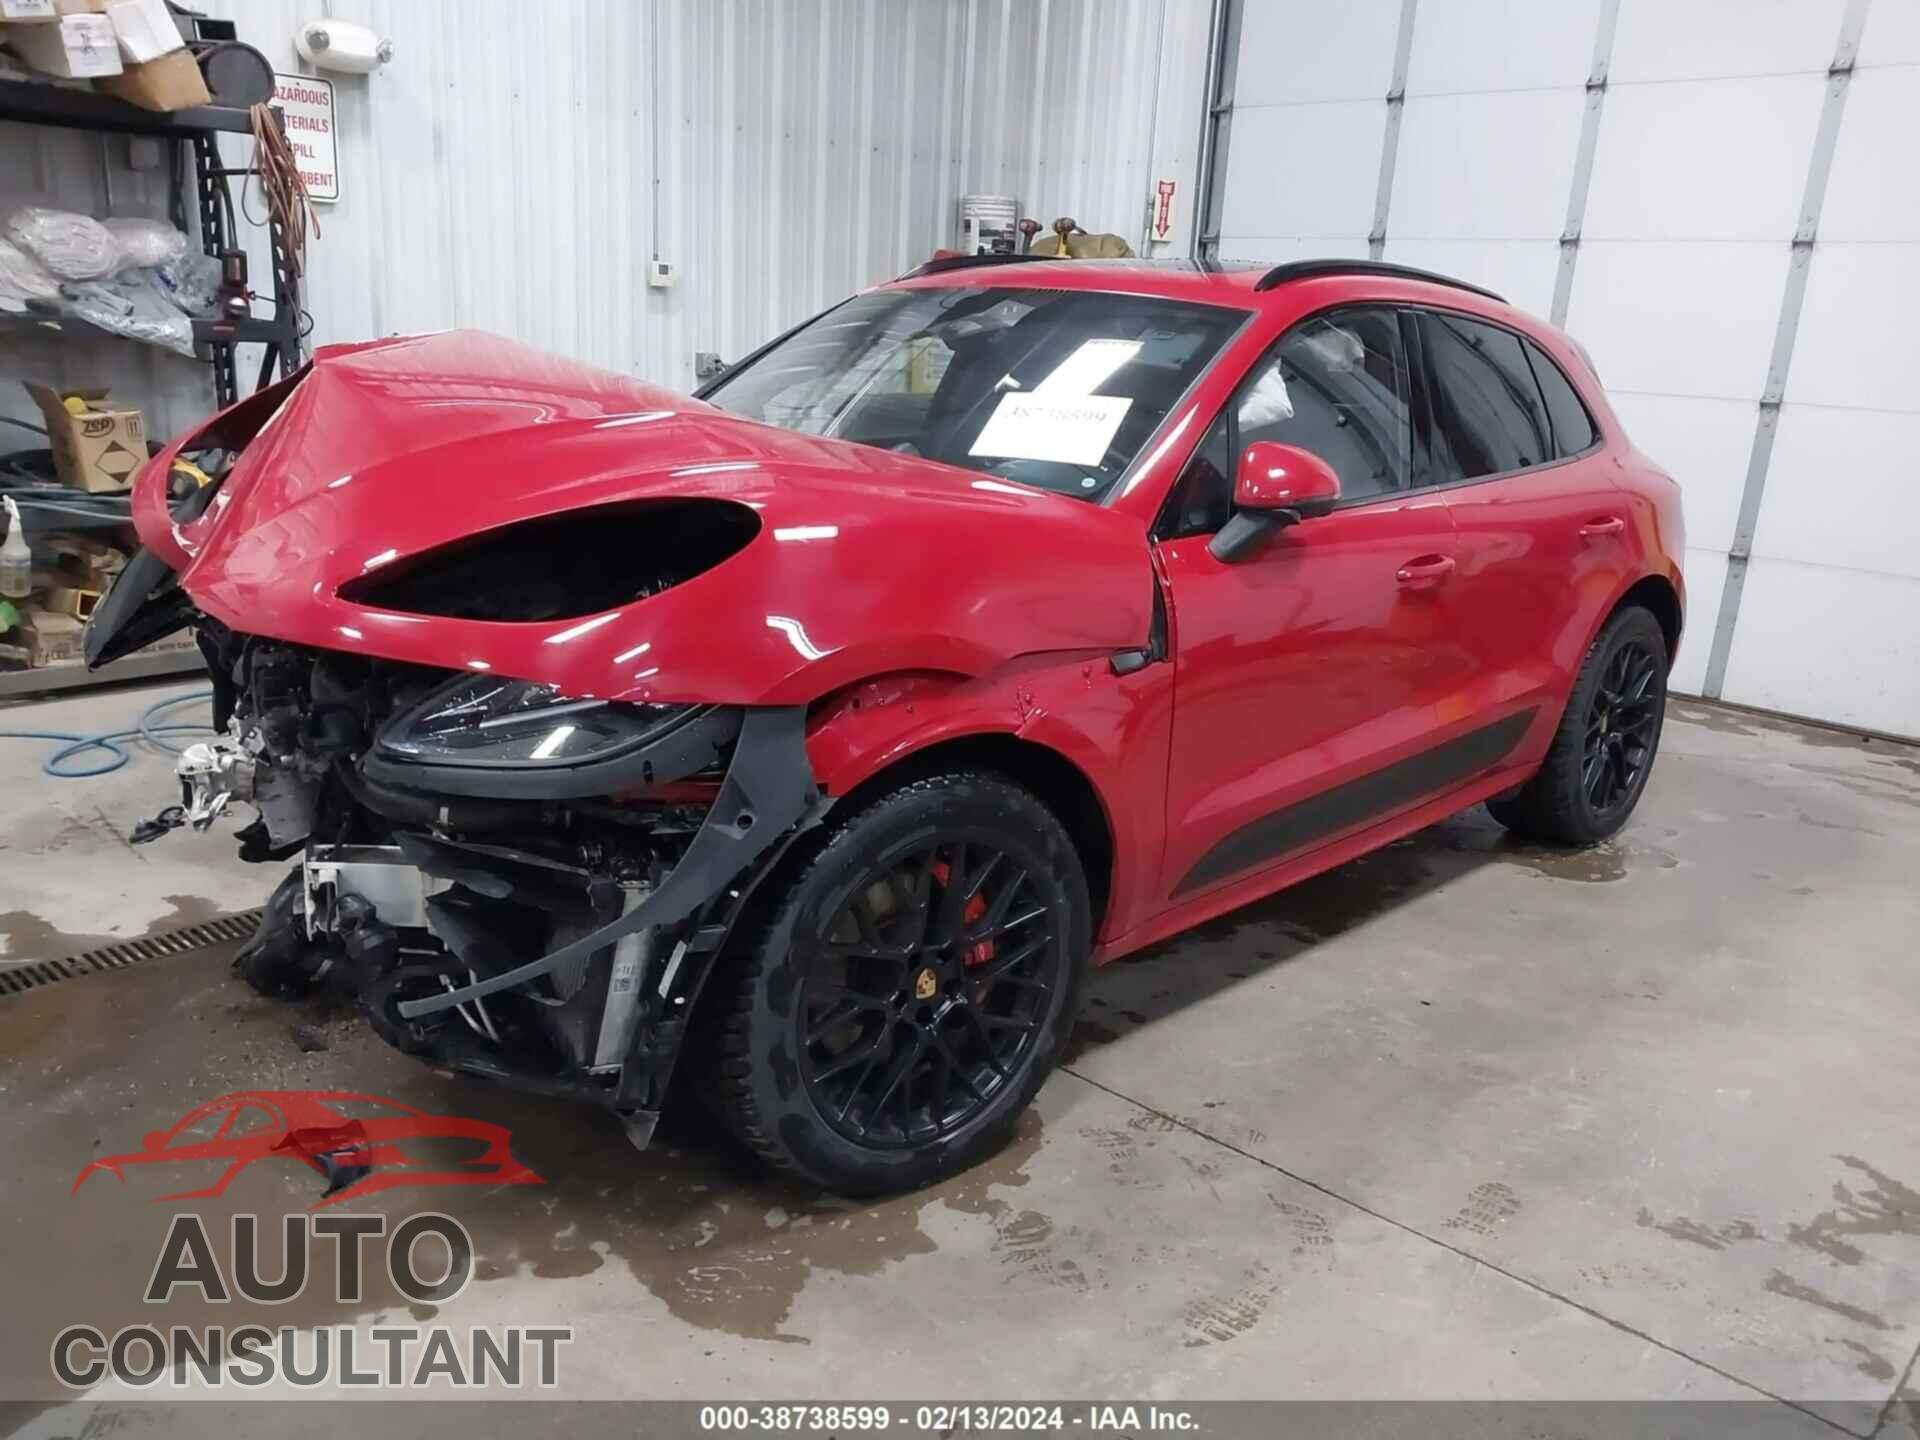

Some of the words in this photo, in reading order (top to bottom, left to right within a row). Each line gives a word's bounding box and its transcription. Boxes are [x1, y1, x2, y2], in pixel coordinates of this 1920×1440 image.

[272, 86, 330, 106] AZARDOUS
[285, 114, 329, 133] TERIALS
[292, 143, 317, 159] PILL
